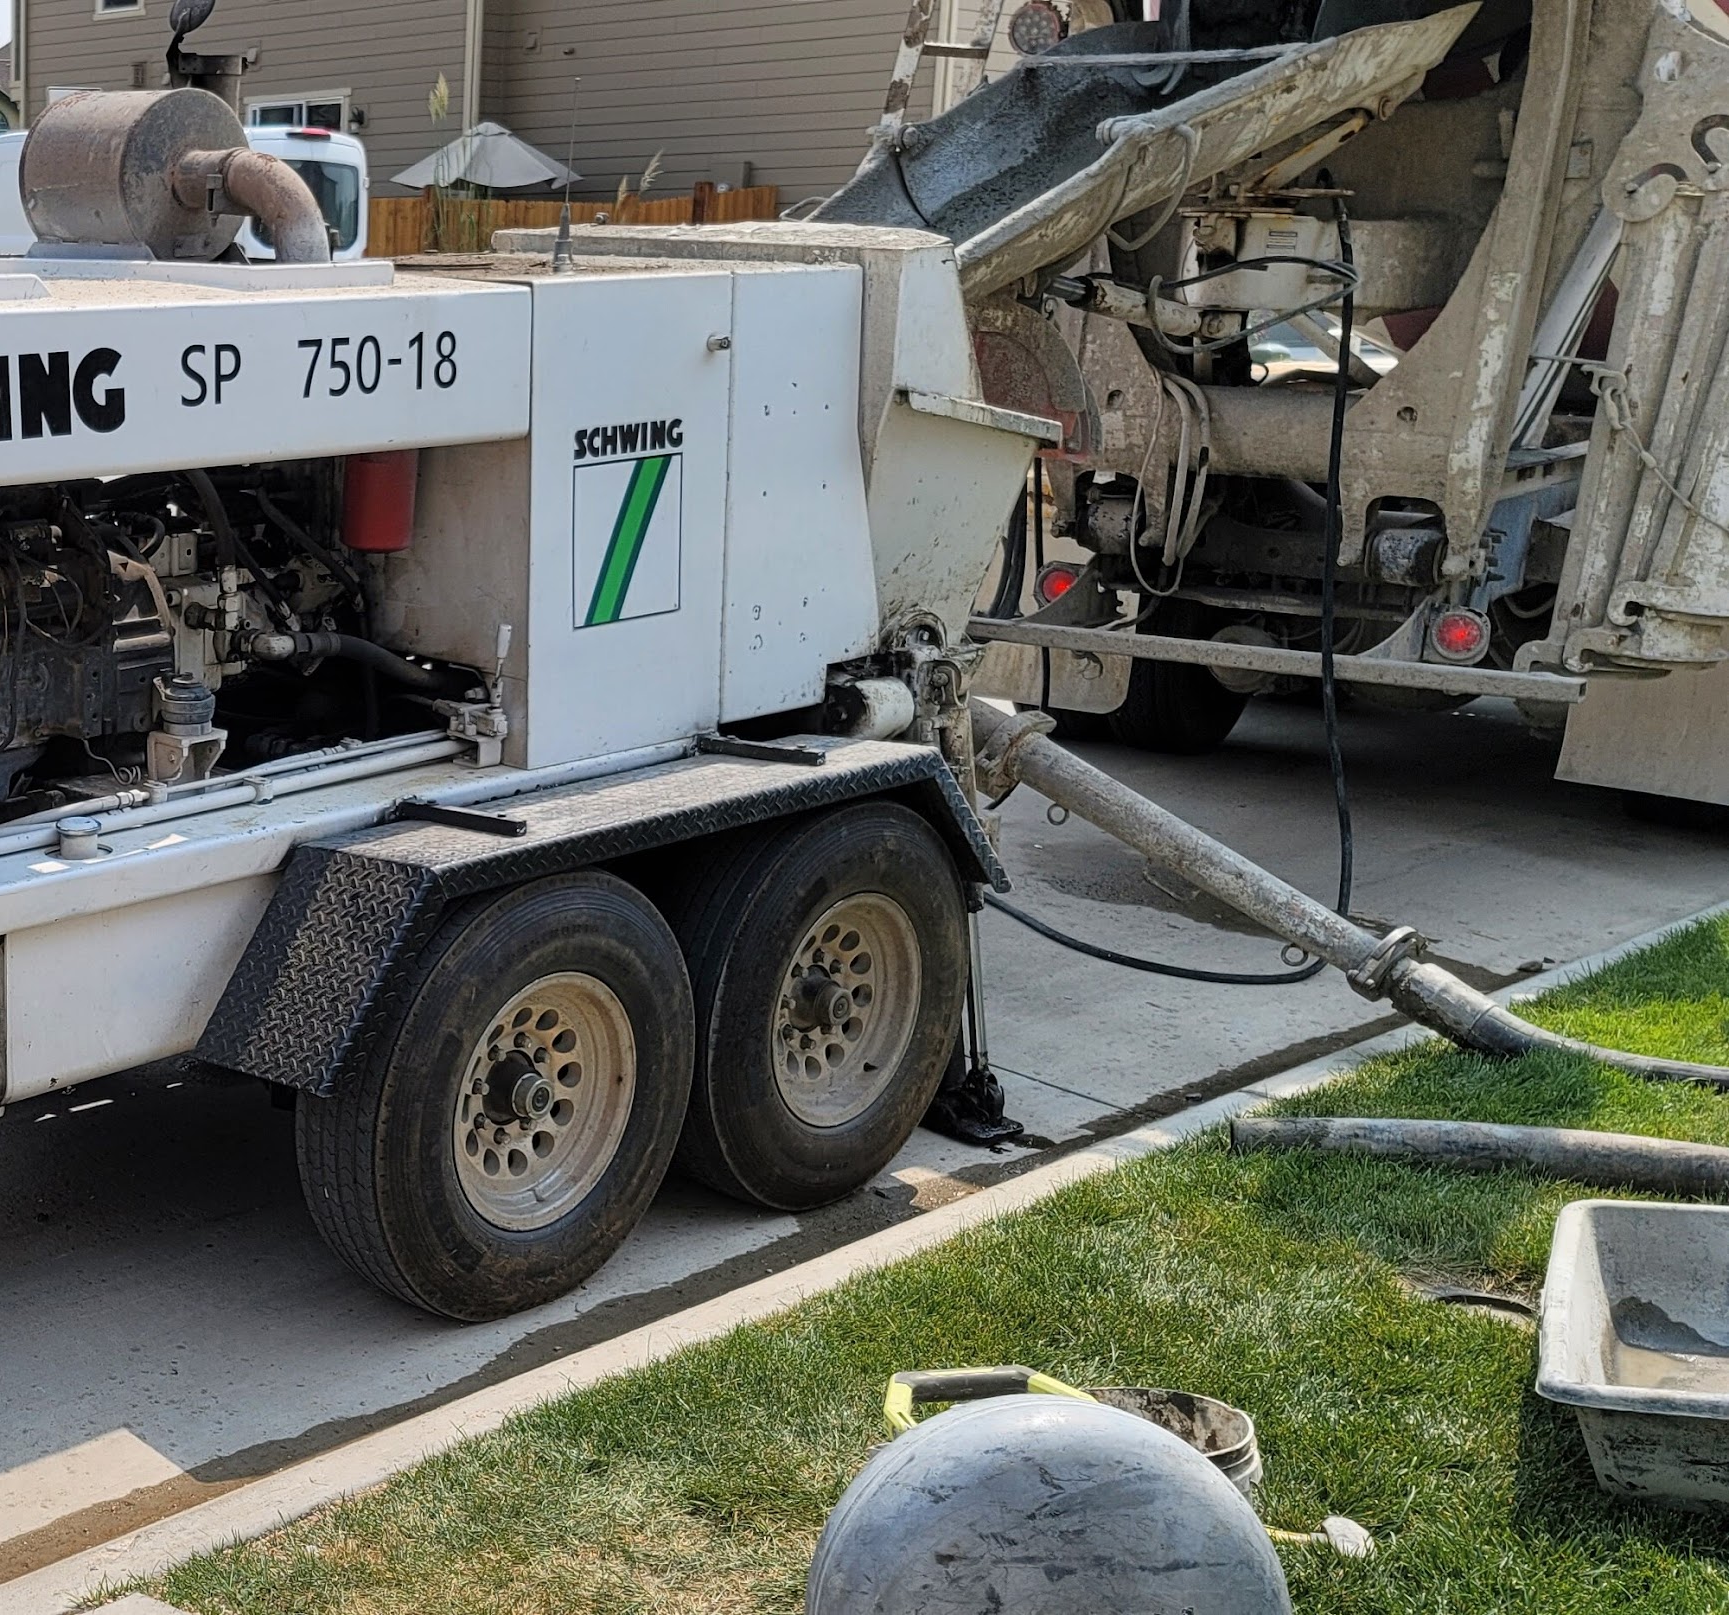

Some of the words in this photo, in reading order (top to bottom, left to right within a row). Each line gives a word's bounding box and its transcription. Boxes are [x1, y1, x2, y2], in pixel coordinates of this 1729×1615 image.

[180, 343, 241, 408] SP
[296, 330, 458, 399] 750-18
[573, 418, 684, 460] SCHWING
